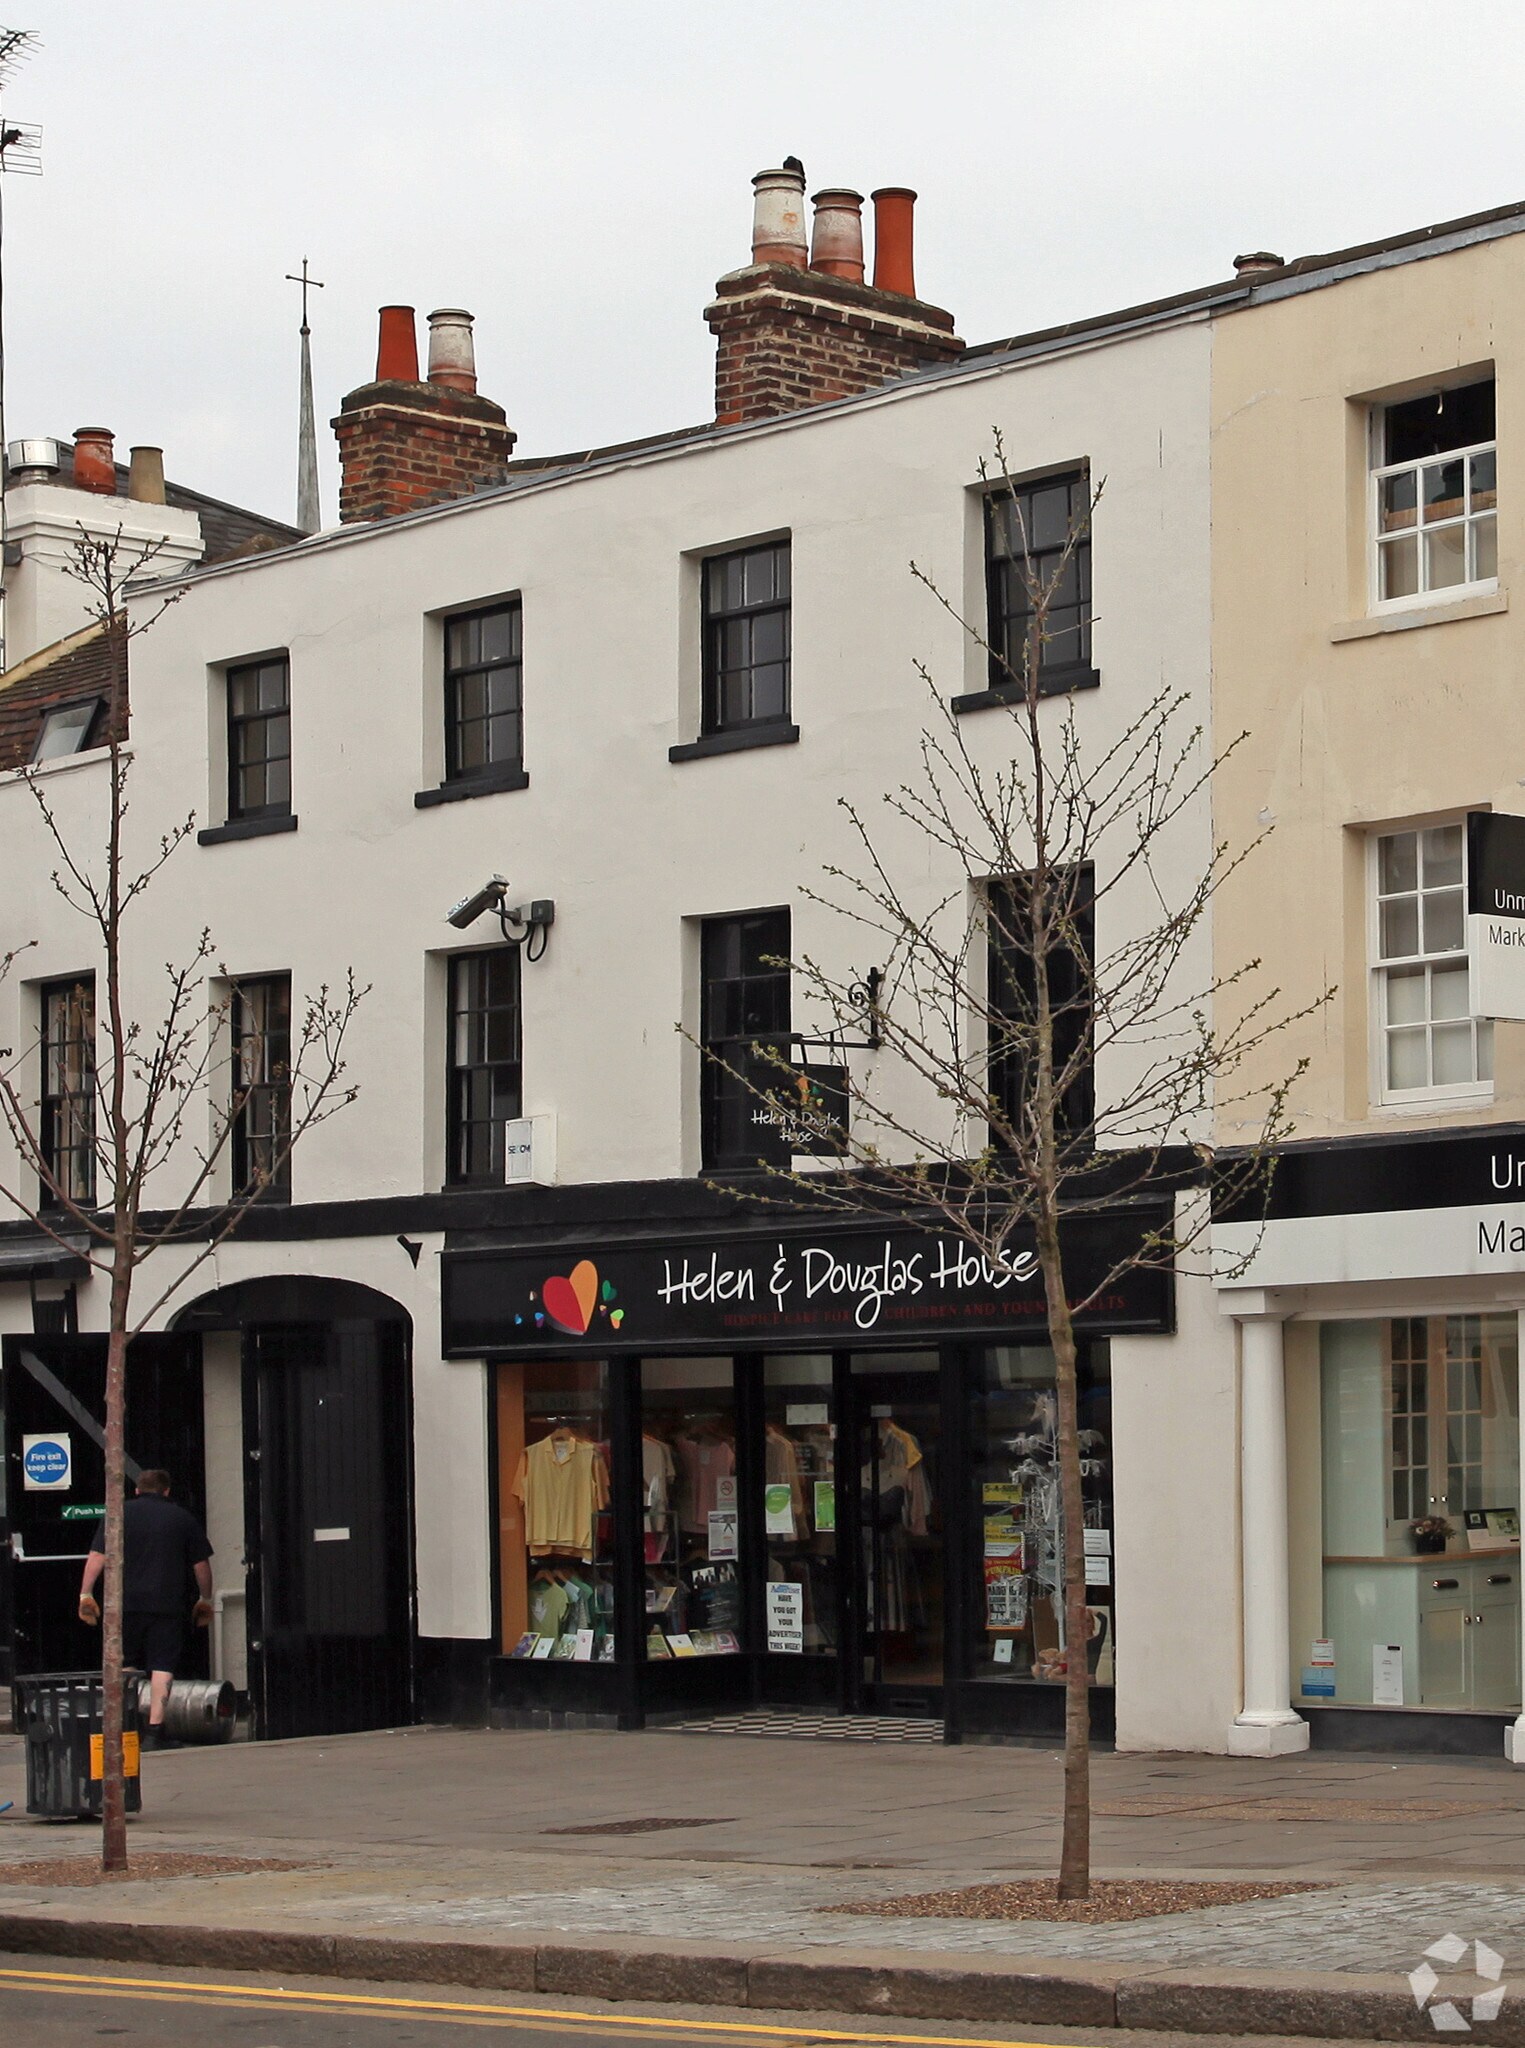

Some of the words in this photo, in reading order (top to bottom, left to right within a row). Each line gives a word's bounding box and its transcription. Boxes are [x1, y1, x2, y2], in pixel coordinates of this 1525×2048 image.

[1479, 1219, 1525, 1254] Ma
[657, 1252, 755, 1304] Helen
[769, 1243, 793, 1313] &
[801, 1240, 924, 1329] Douglas
[930, 1240, 1038, 1290] House
[884, 1304, 957, 1320] CHILDREN
[963, 1302, 996, 1317] AND
[1002, 1300, 1047, 1316] YOUN
[30, 1453, 46, 1462] Fire
[47, 1453, 62, 1461] exit
[27, 1463, 46, 1472] keep
[47, 1462, 66, 1471] clear
[74, 1507, 93, 1515] Push
